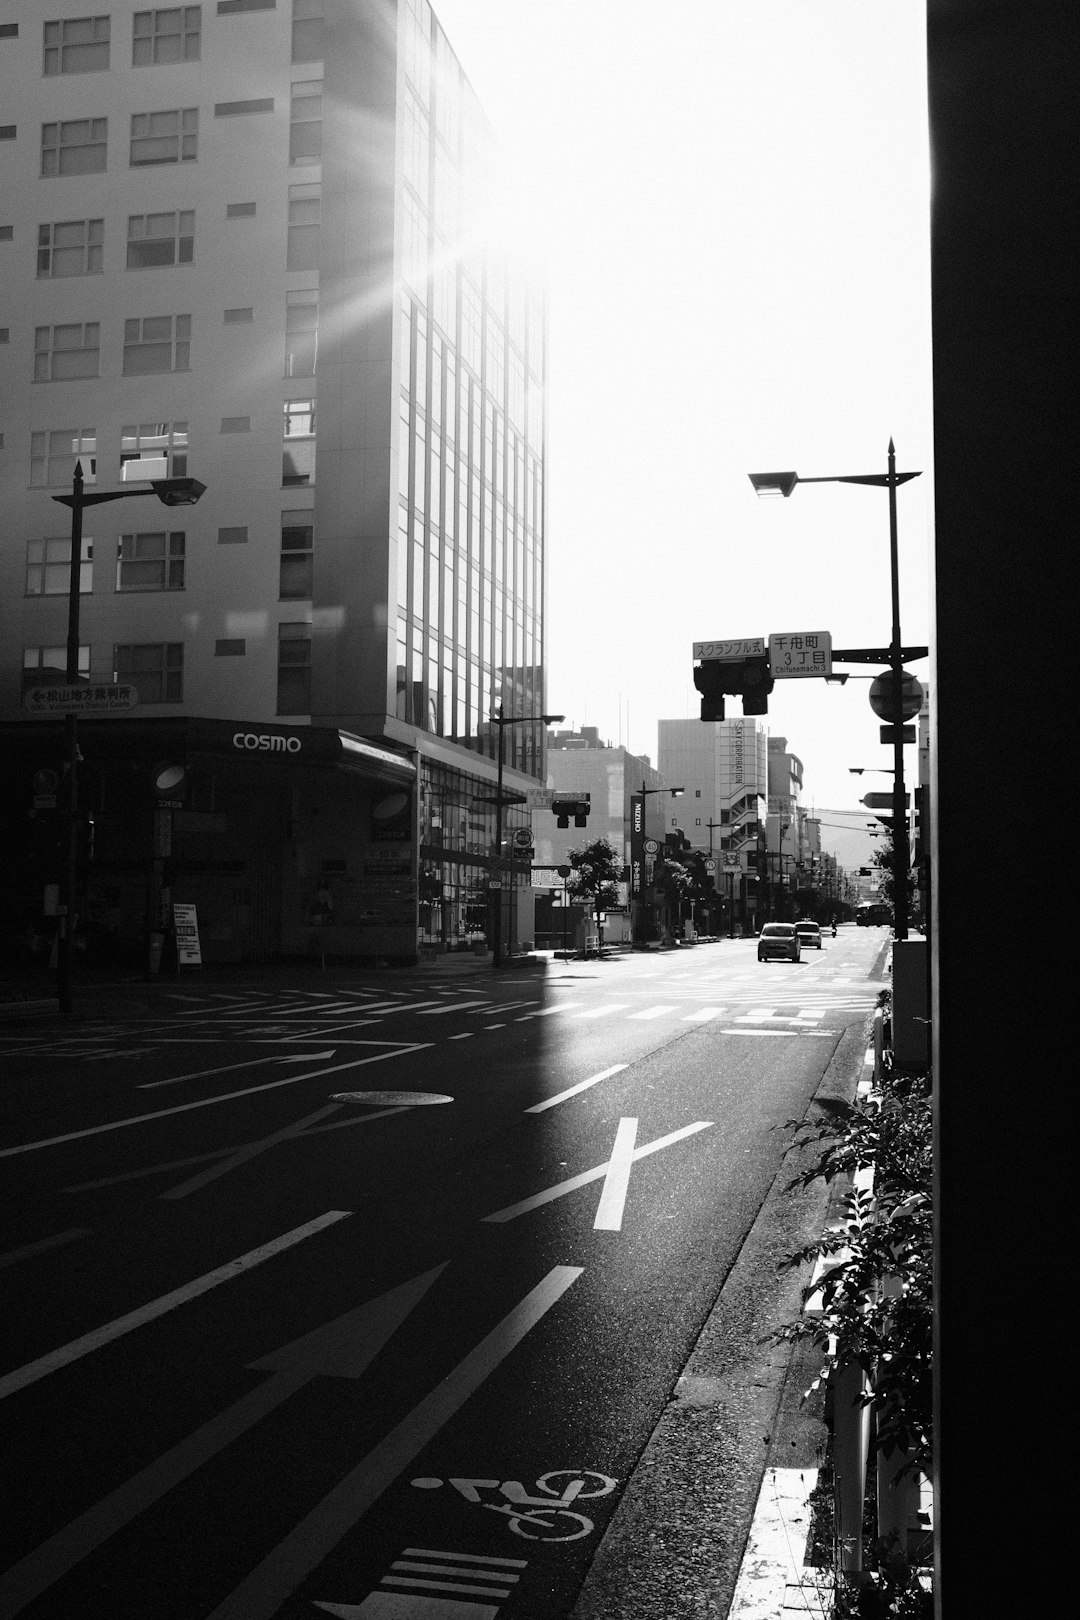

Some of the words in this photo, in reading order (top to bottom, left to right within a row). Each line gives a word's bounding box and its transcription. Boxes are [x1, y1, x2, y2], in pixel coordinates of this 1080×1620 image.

[697, 641, 761, 657] スクランブル式
[774, 635, 818, 650] 千舟町
[784, 650, 826, 666] 3丁目
[775, 664, 820, 674] Chifunemachi
[820, 664, 826, 672] 3
[47, 686, 131, 702] 松山地方裁判所
[86, 701, 108, 710] District
[232, 733, 302, 753] COSMO
[634, 803, 642, 833] MIZUHO
[647, 843, 657, 851] 40
